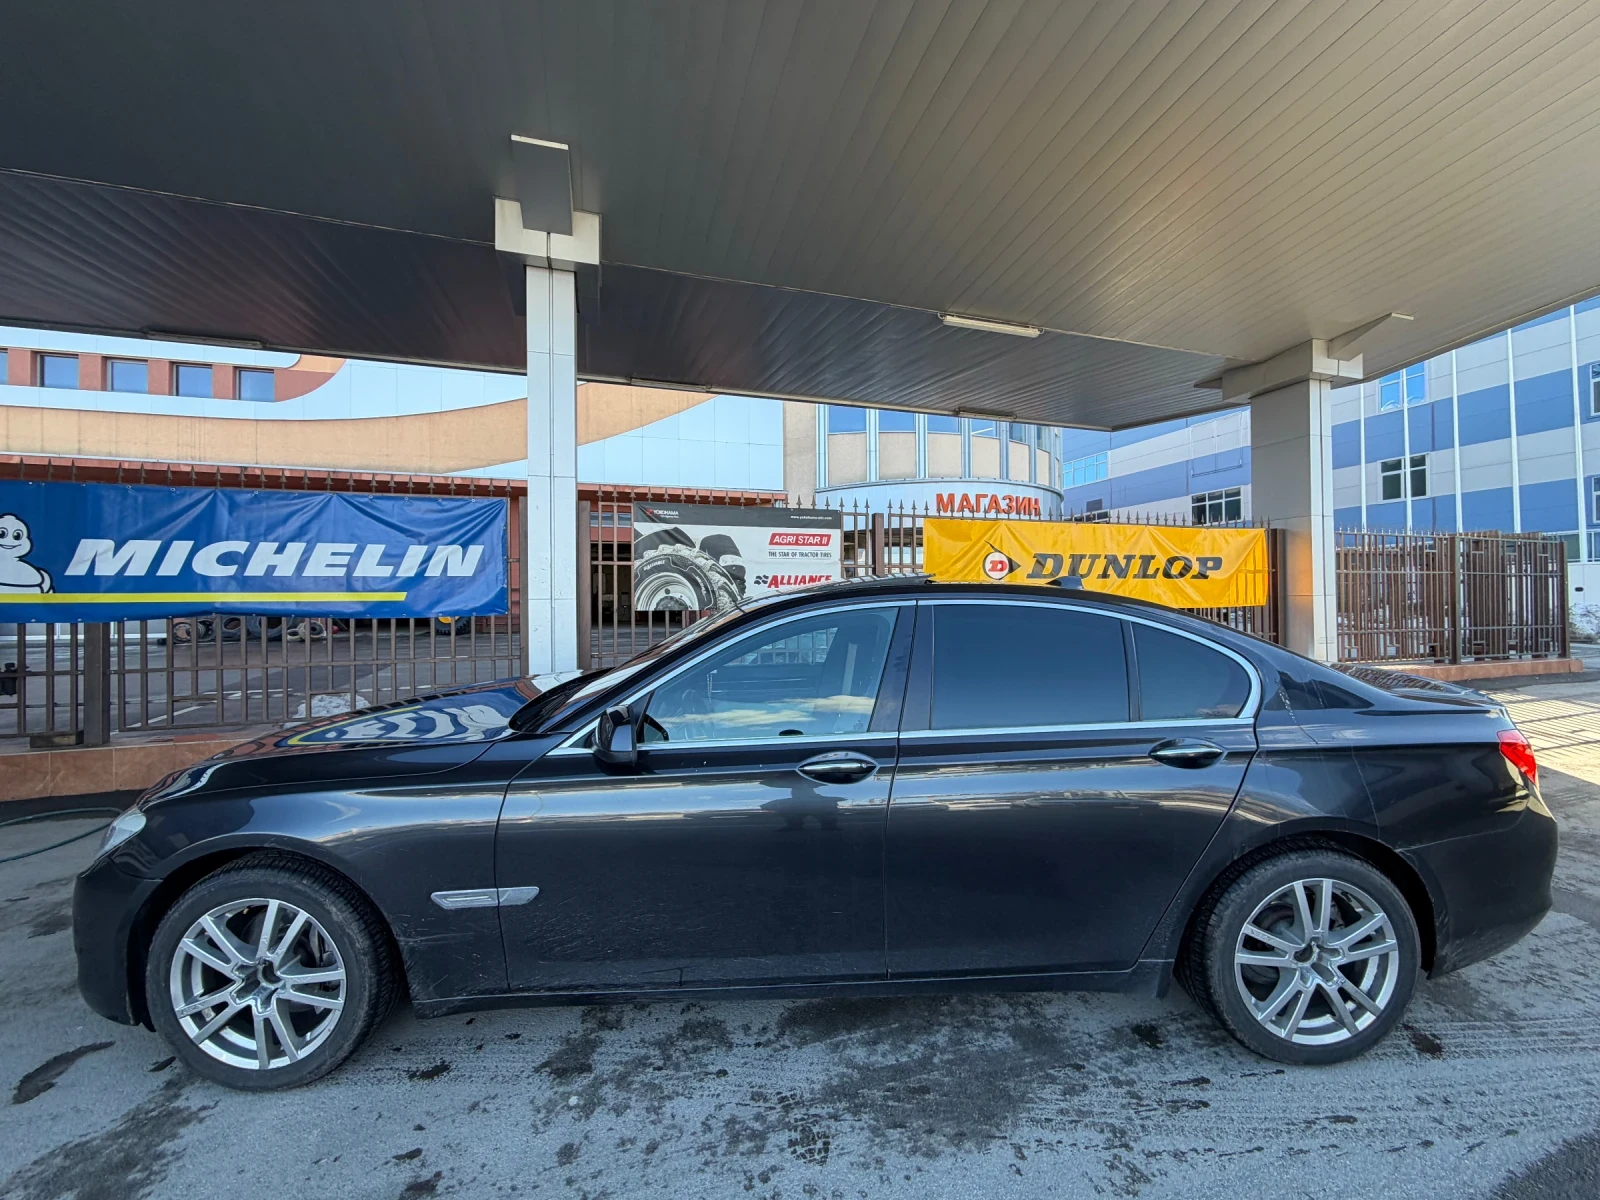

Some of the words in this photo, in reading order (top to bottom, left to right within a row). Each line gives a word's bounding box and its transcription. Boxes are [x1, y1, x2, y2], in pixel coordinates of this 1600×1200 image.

[936, 493, 1040, 516] МАГАЗИН
[772, 535, 797, 544] AGRI
[797, 535, 821, 545] STAR
[64, 538, 484, 577] MICHELIN
[988, 560, 1008, 572] D
[1026, 552, 1223, 580] DUNLOP
